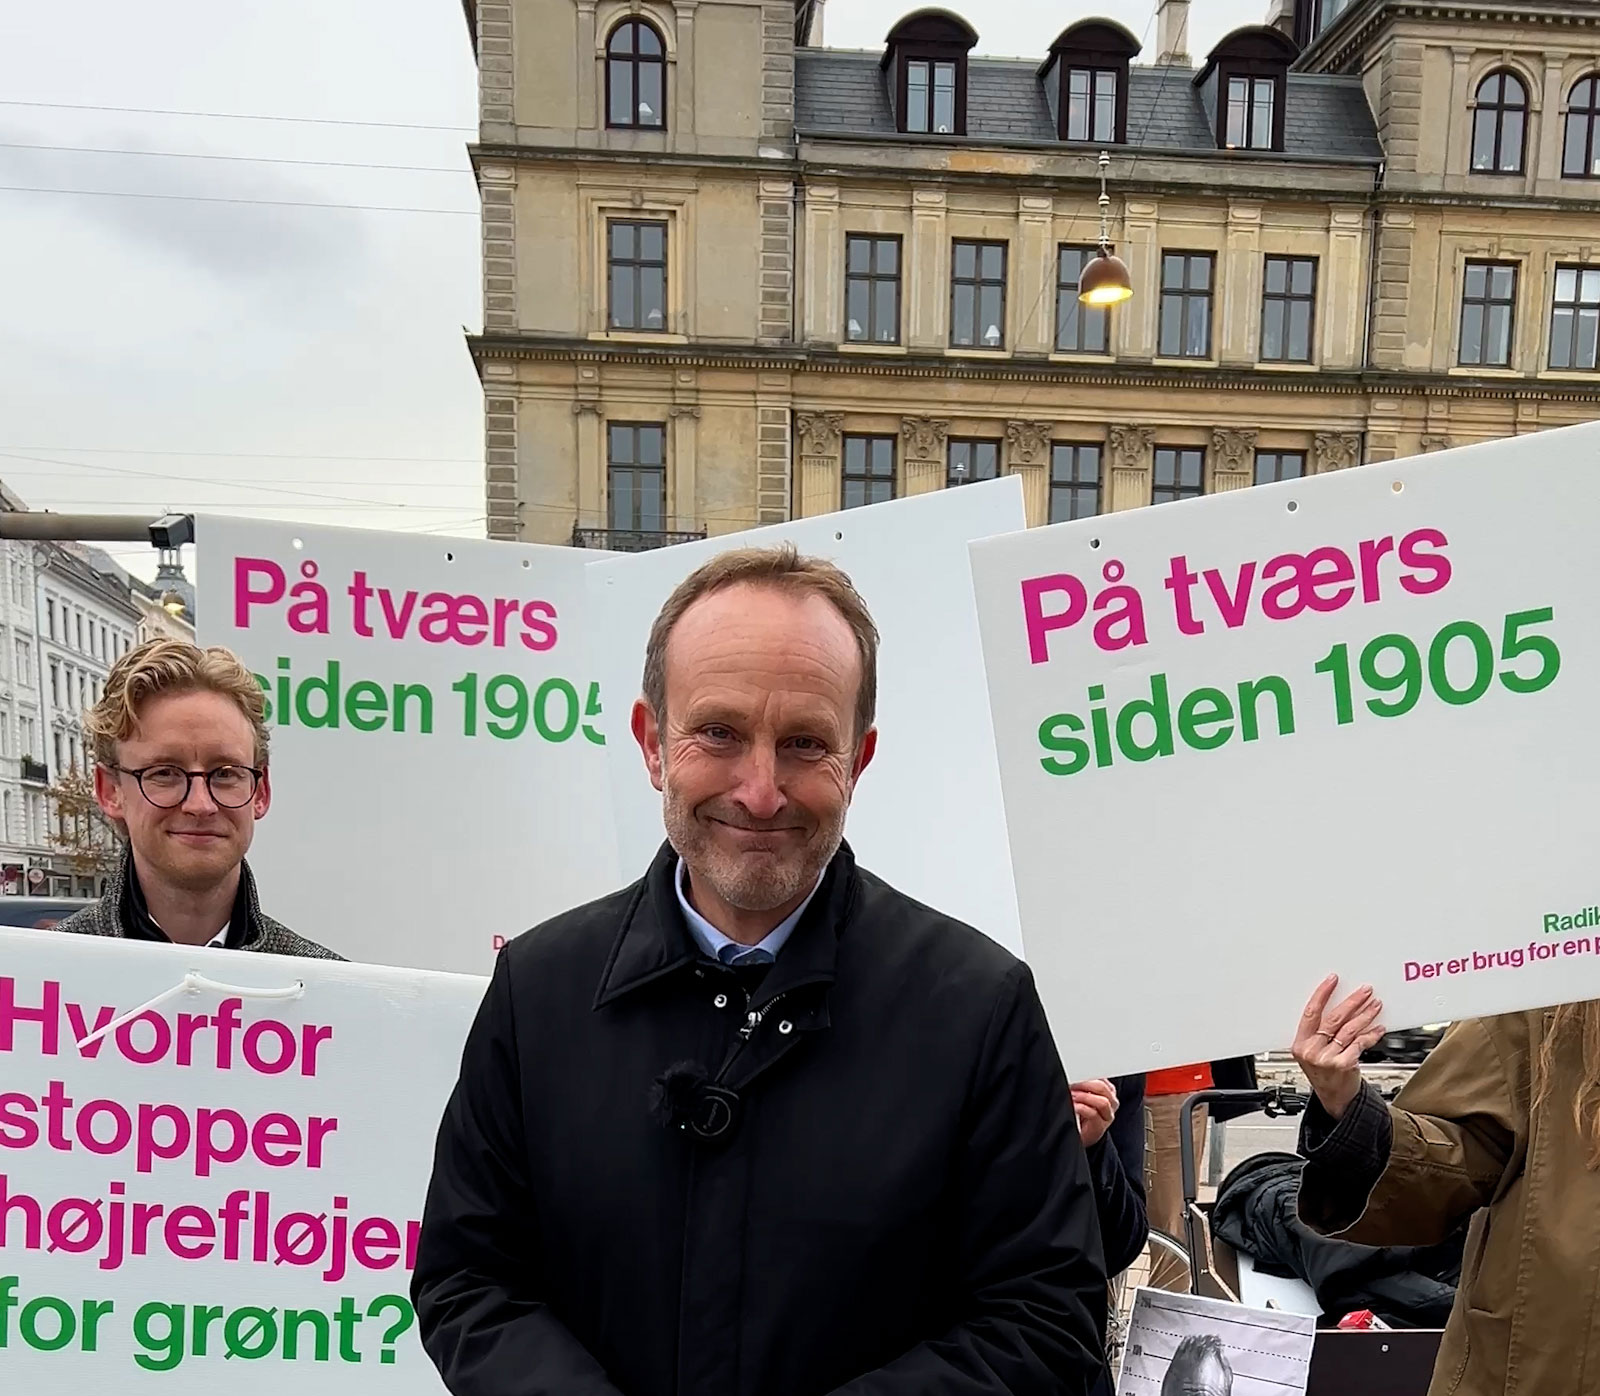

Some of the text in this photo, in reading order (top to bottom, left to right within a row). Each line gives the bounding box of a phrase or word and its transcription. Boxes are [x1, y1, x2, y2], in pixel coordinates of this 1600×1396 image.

[233, 557, 558, 652] På tværs
[1020, 527, 1454, 665] På tværs
[1037, 606, 1562, 777] siden 1905
[1404, 961, 1444, 982] Der
[1447, 957, 1470, 974] er
[1472, 948, 1525, 971] brug
[1528, 942, 1560, 961] for
[1563, 937, 1591, 956] en
[0, 976, 333, 1077] Hvorfor
[0, 1080, 339, 1178] stopper
[0, 1173, 421, 1284] højrefløje
[0, 1274, 417, 1375] for grønt?
